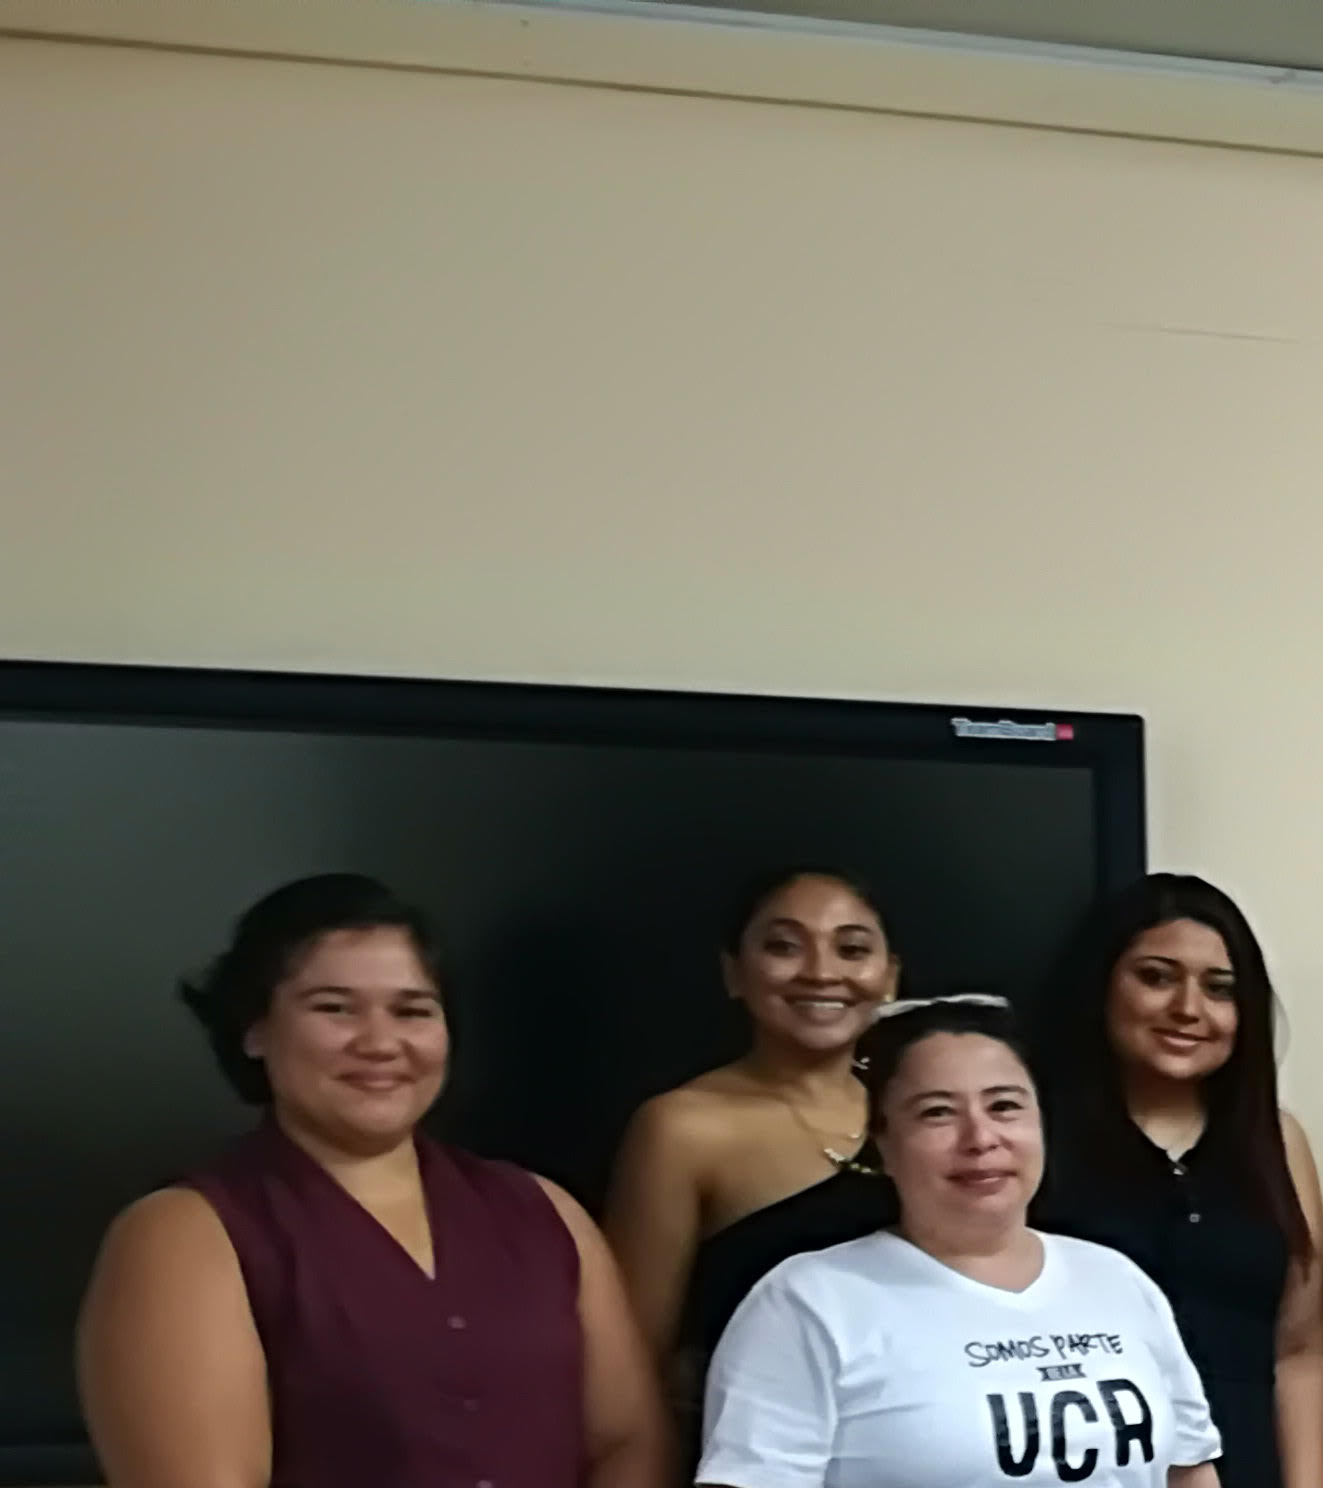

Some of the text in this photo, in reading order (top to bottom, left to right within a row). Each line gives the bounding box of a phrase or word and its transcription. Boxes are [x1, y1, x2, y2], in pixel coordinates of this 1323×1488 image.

[963, 1333, 1123, 1368] SOMOS PARTE
[985, 1377, 1155, 1483] UCR
